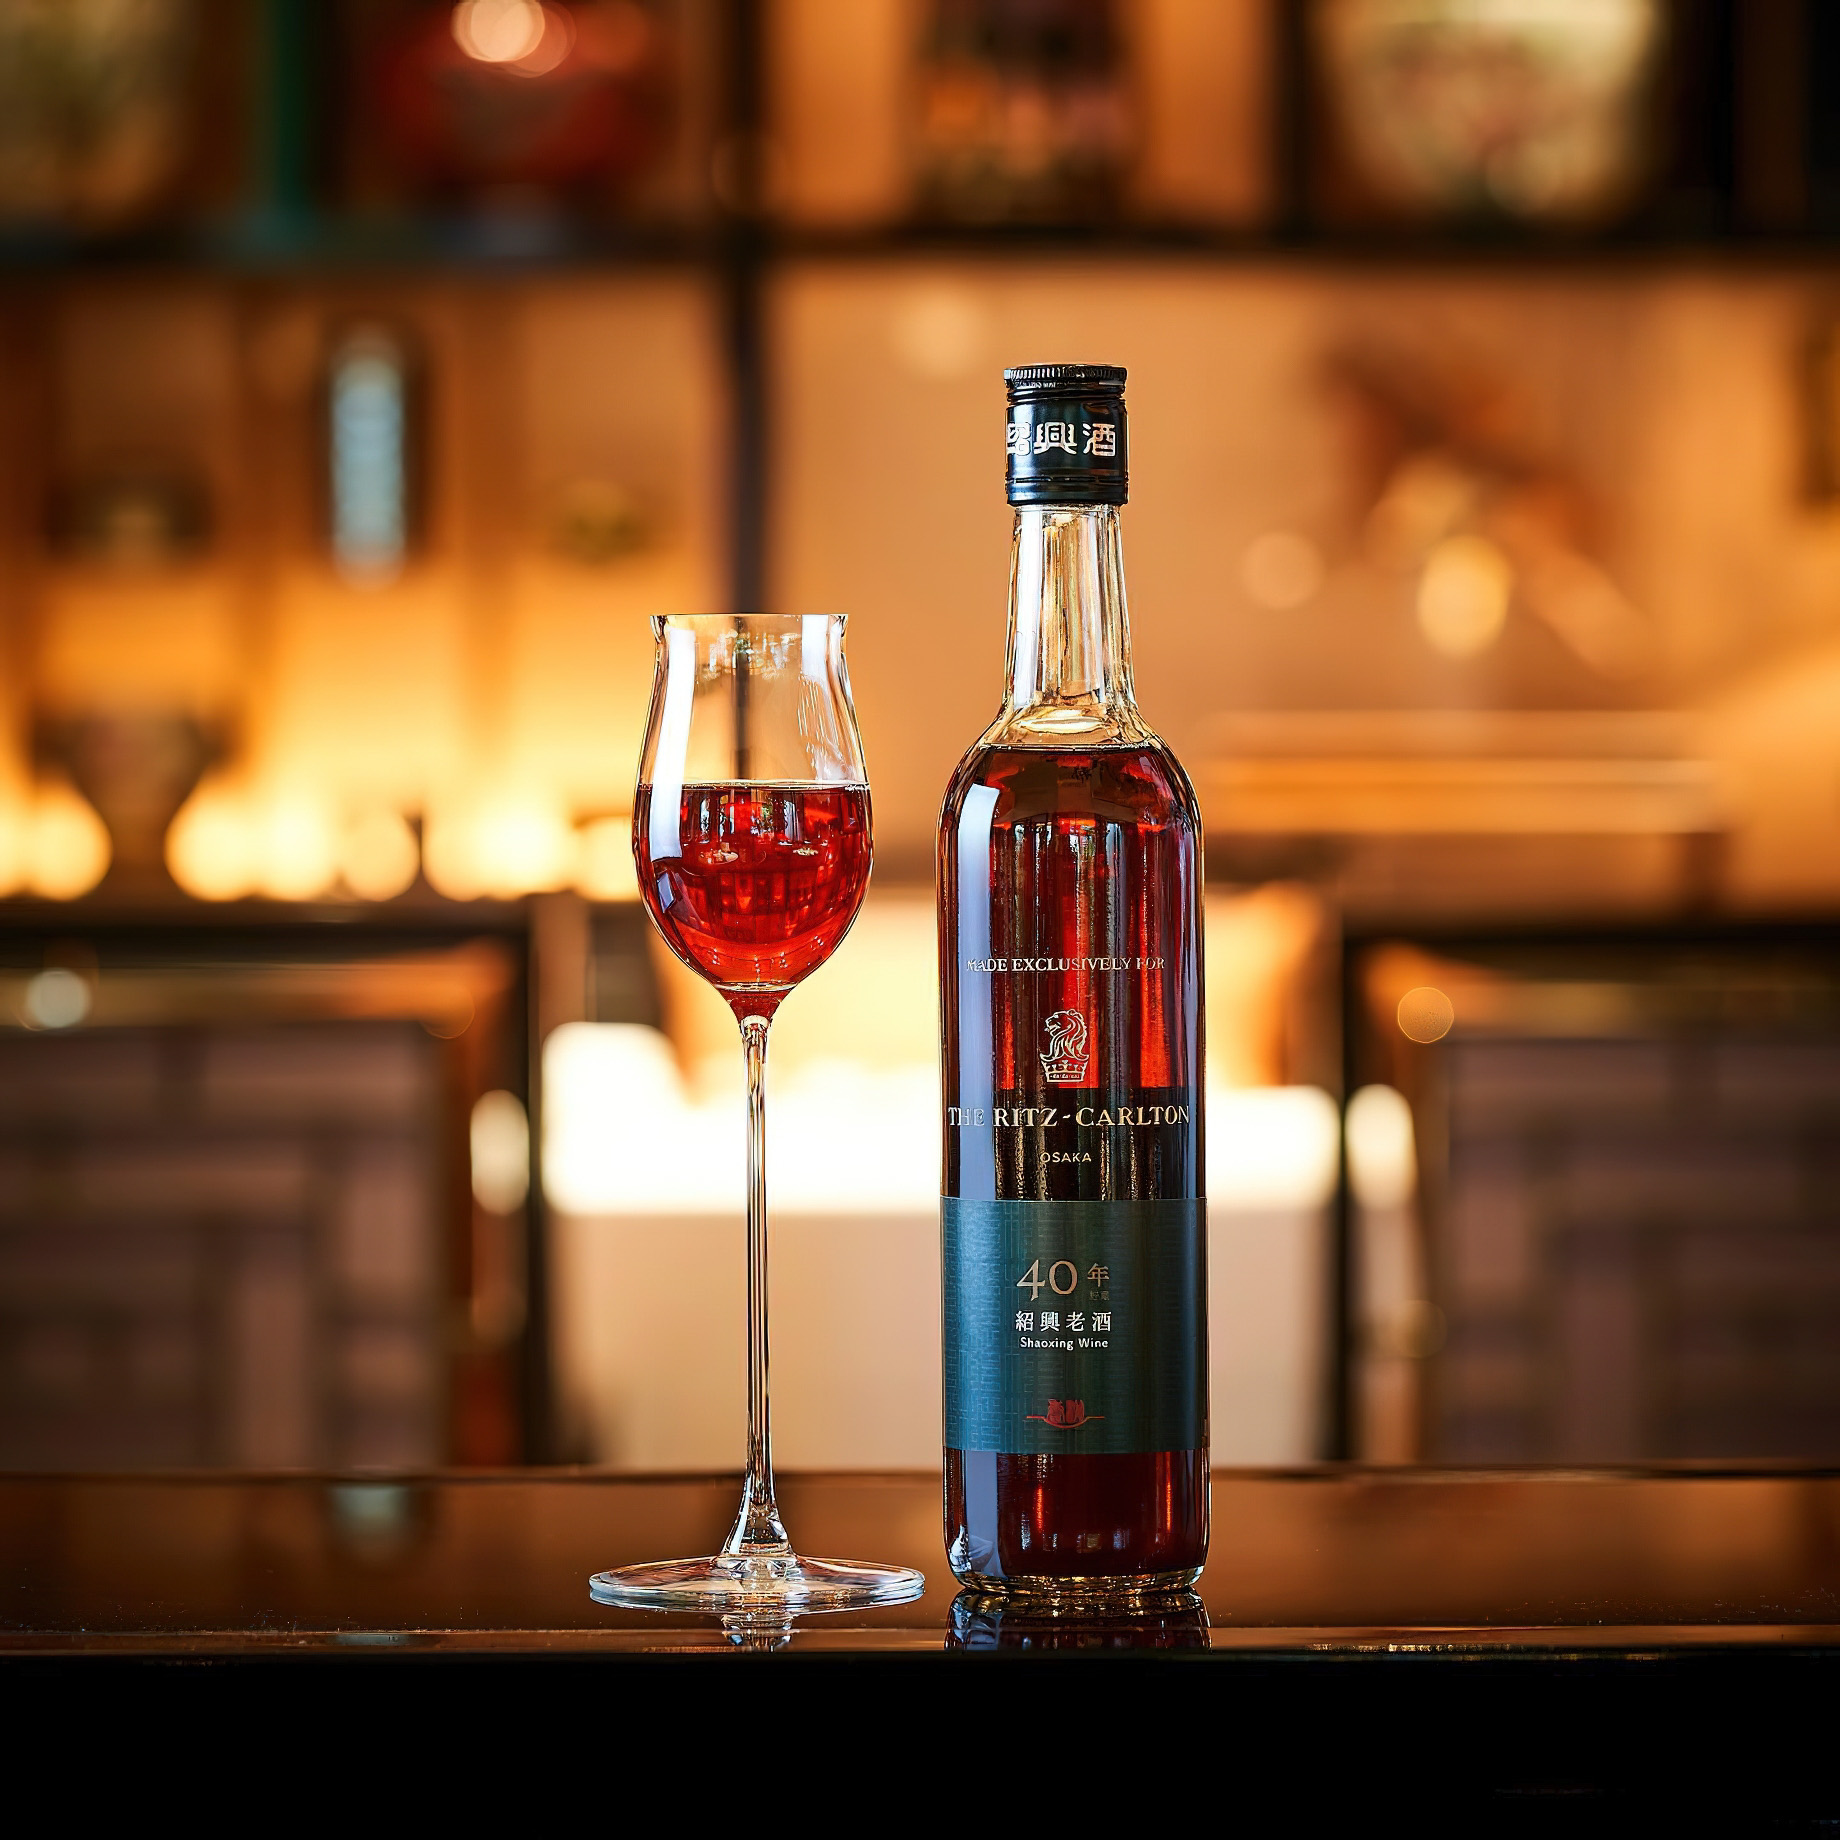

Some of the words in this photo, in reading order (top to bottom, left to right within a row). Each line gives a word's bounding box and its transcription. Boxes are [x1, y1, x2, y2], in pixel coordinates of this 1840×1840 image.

[967, 957, 1008, 972] MADE
[1011, 957, 1132, 972] EXCLUSIVELY
[1136, 957, 1166, 971] FOR
[948, 1105, 985, 1127] THE
[1039, 1151, 1093, 1164] OSAKA
[1015, 1310, 1112, 1332] 紹興老酒
[1019, 1336, 1074, 1351] Shaoxing
[1078, 1337, 1109, 1348] Wine
